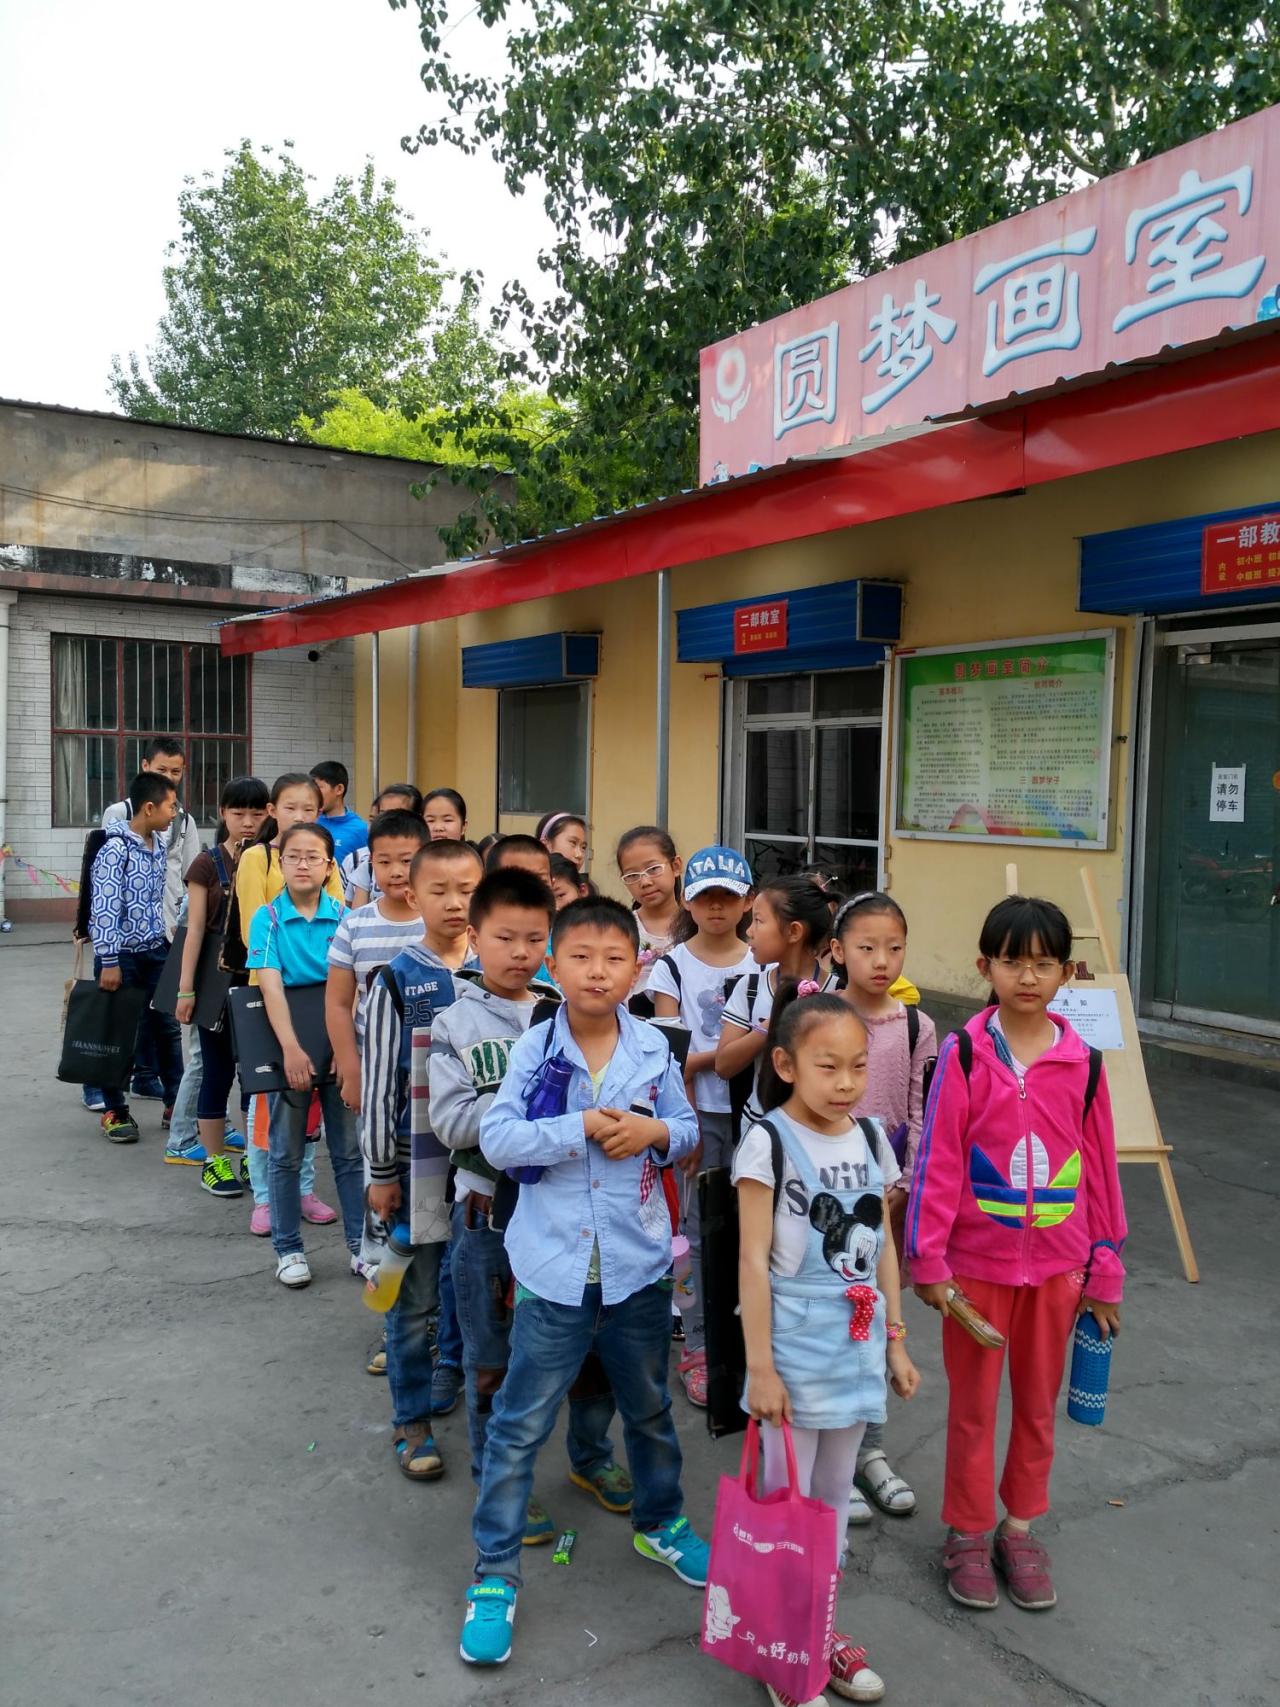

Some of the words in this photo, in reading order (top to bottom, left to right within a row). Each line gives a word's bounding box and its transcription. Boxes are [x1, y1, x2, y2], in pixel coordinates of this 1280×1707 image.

[773, 165, 1266, 440] 圆梦画室
[740, 609, 780, 628] 二部教室
[1216, 783, 1239, 796] 请勿
[1216, 800, 1239, 812] 停车
[688, 854, 745, 879] ITALIA
